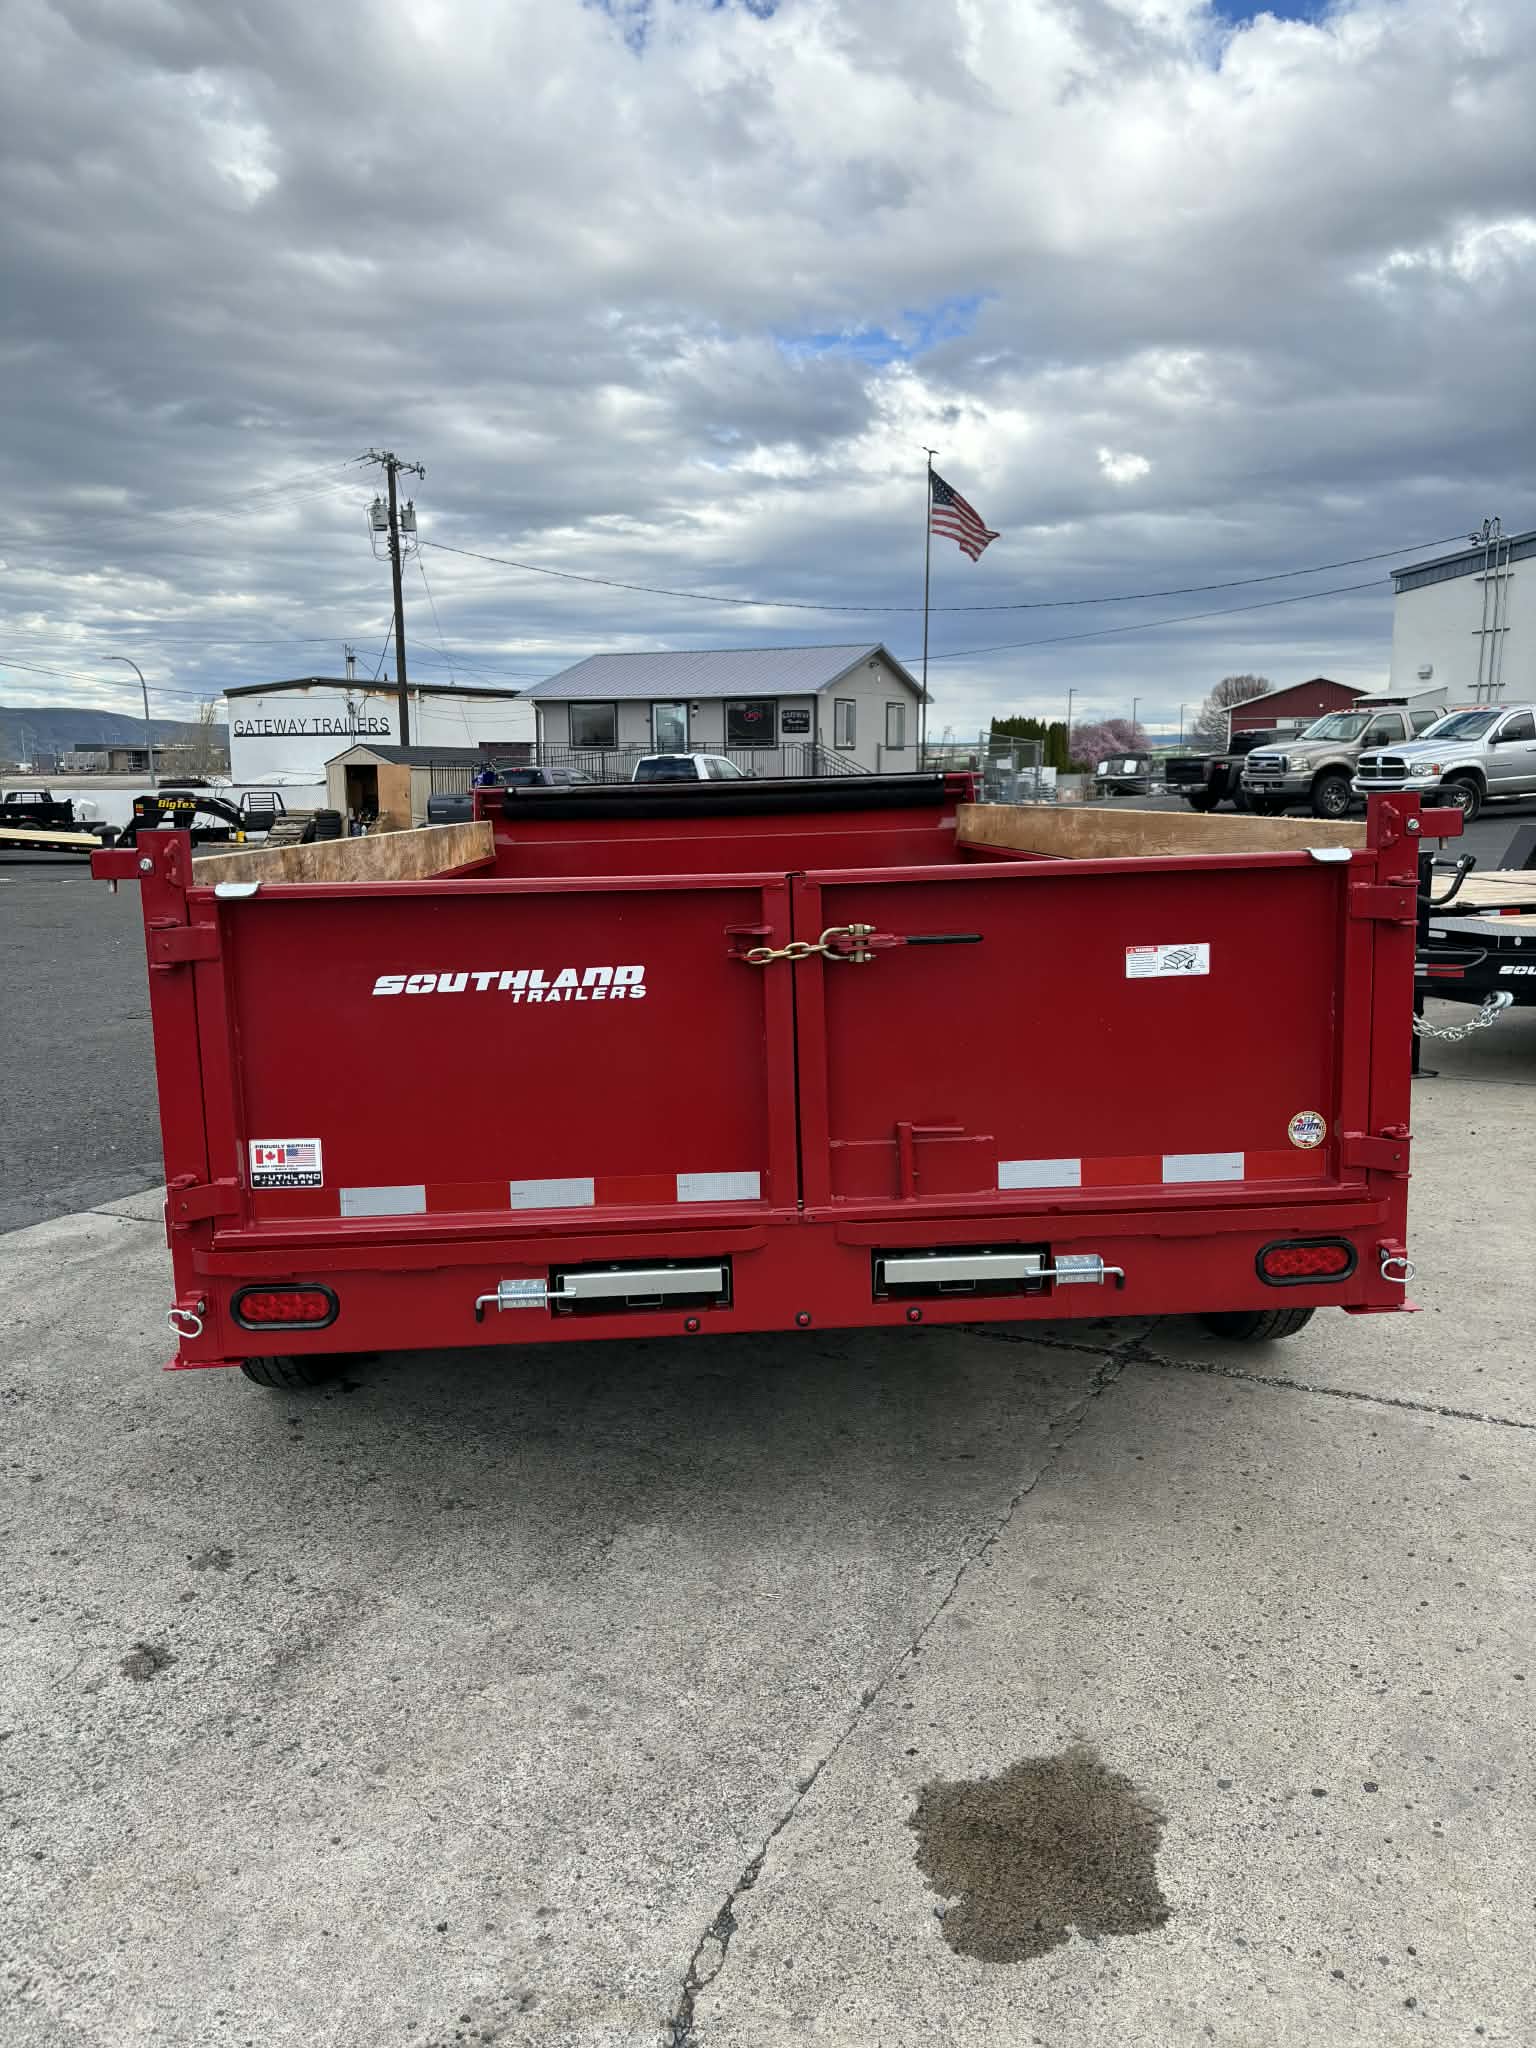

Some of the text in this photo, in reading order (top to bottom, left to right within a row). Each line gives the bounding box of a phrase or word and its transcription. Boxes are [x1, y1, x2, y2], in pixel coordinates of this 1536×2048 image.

[234, 717, 390, 734] GATEWAY TRAILERS
[372, 965, 646, 996] SOUTHLAND
[511, 984, 647, 1003] TRAILERS
